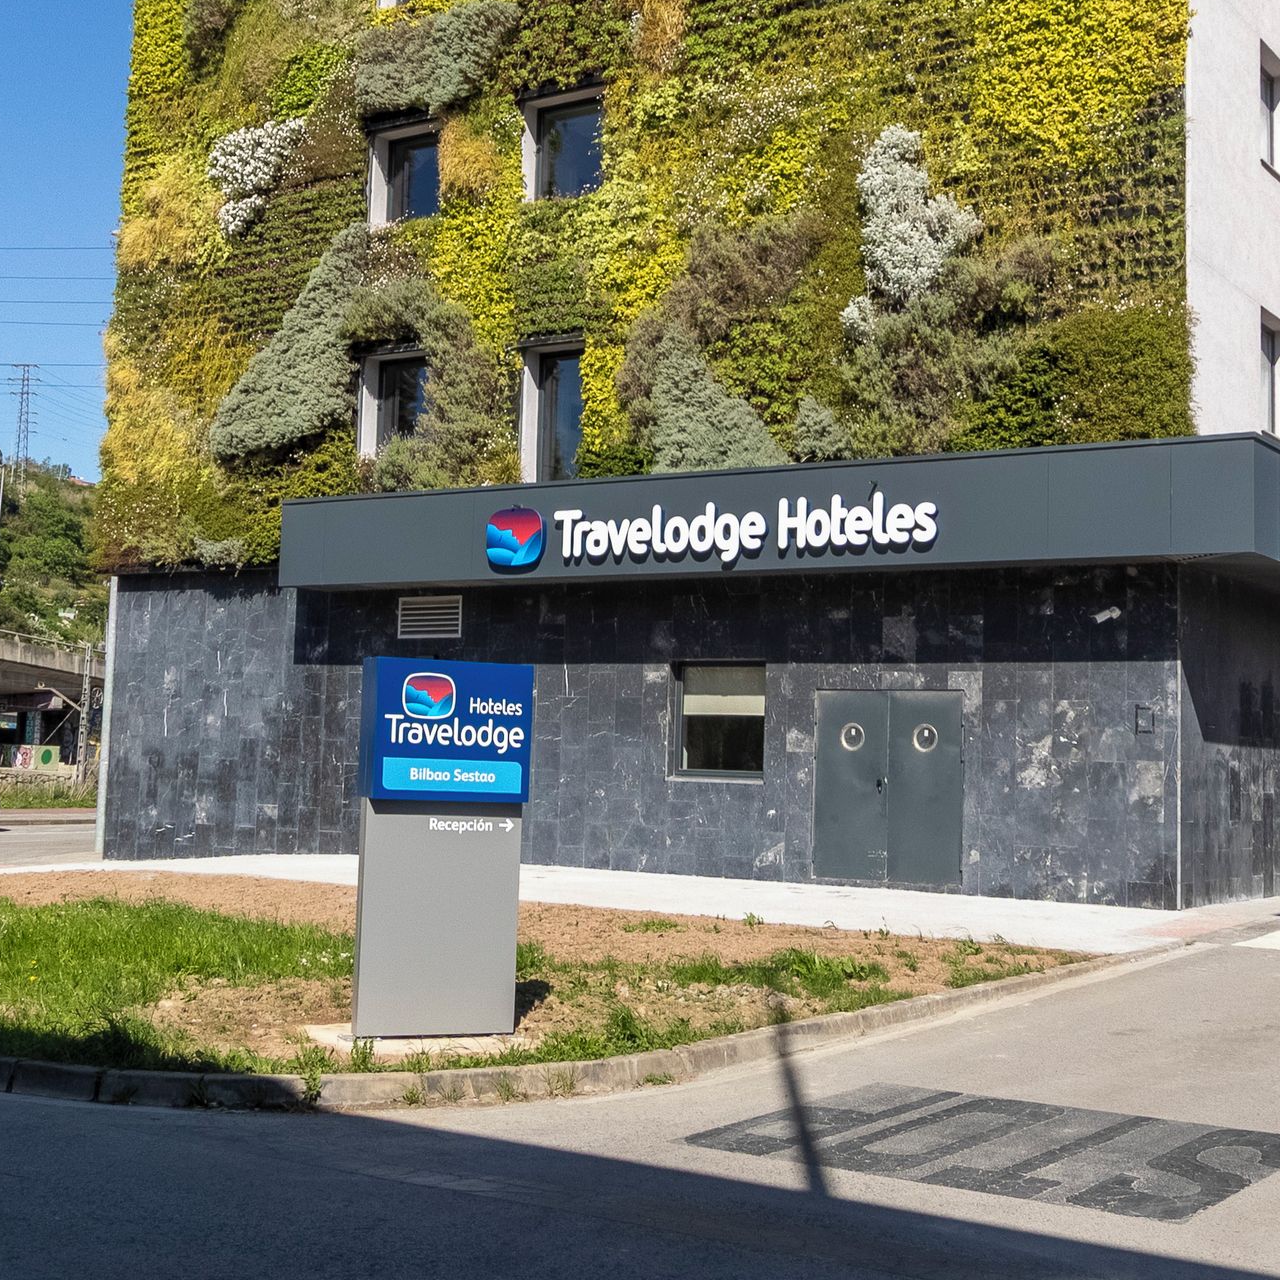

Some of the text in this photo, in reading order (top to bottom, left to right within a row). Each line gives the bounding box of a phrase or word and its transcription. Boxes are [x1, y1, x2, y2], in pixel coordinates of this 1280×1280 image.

[553, 491, 937, 562] Travelodge Hoteles
[469, 696, 523, 716] Hoteles
[384, 714, 525, 754] Travelodge
[409, 767, 496, 783] Bilbao Sestao
[429, 817, 493, 834] Recepción
